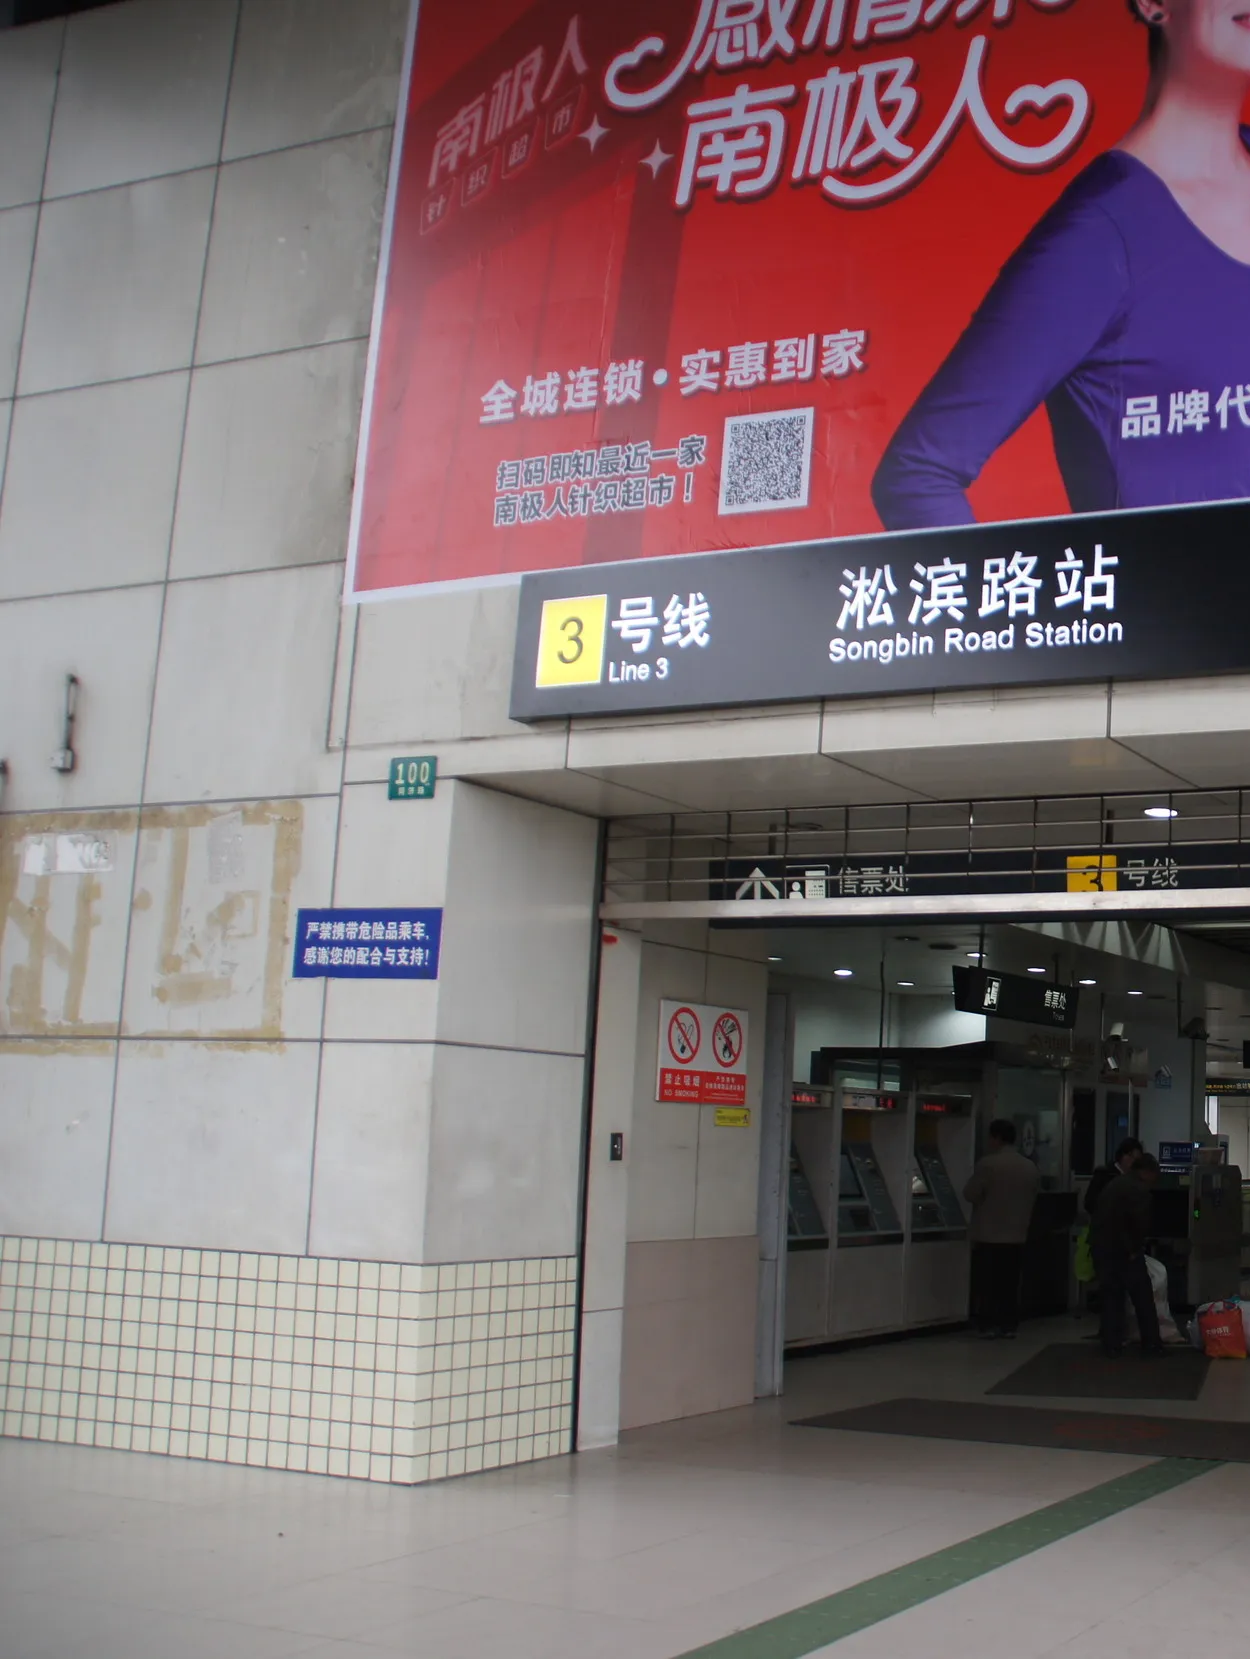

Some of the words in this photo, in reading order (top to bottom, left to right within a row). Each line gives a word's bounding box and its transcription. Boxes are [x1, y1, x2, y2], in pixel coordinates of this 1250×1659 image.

[428, 14, 588, 188] 南极人
[674, 35, 1090, 206] 南极人
[426, 102, 573, 224] 针织超市
[495, 434, 707, 491] 扫码即知最近一家
[493, 470, 695, 527] 南极人针织超市！
[836, 543, 1119, 630] 淞滨路站
[828, 632, 934, 664] Songbin
[944, 623, 1016, 653] Road
[1025, 617, 1124, 647] Station
[608, 660, 651, 683] Line
[655, 656, 670, 679] 3
[394, 761, 430, 785] 100
[838, 864, 911, 895] 售票处
[303, 945, 429, 966] 感谢您的配合与支持！
[674, 1089, 699, 1098] SMOKING
